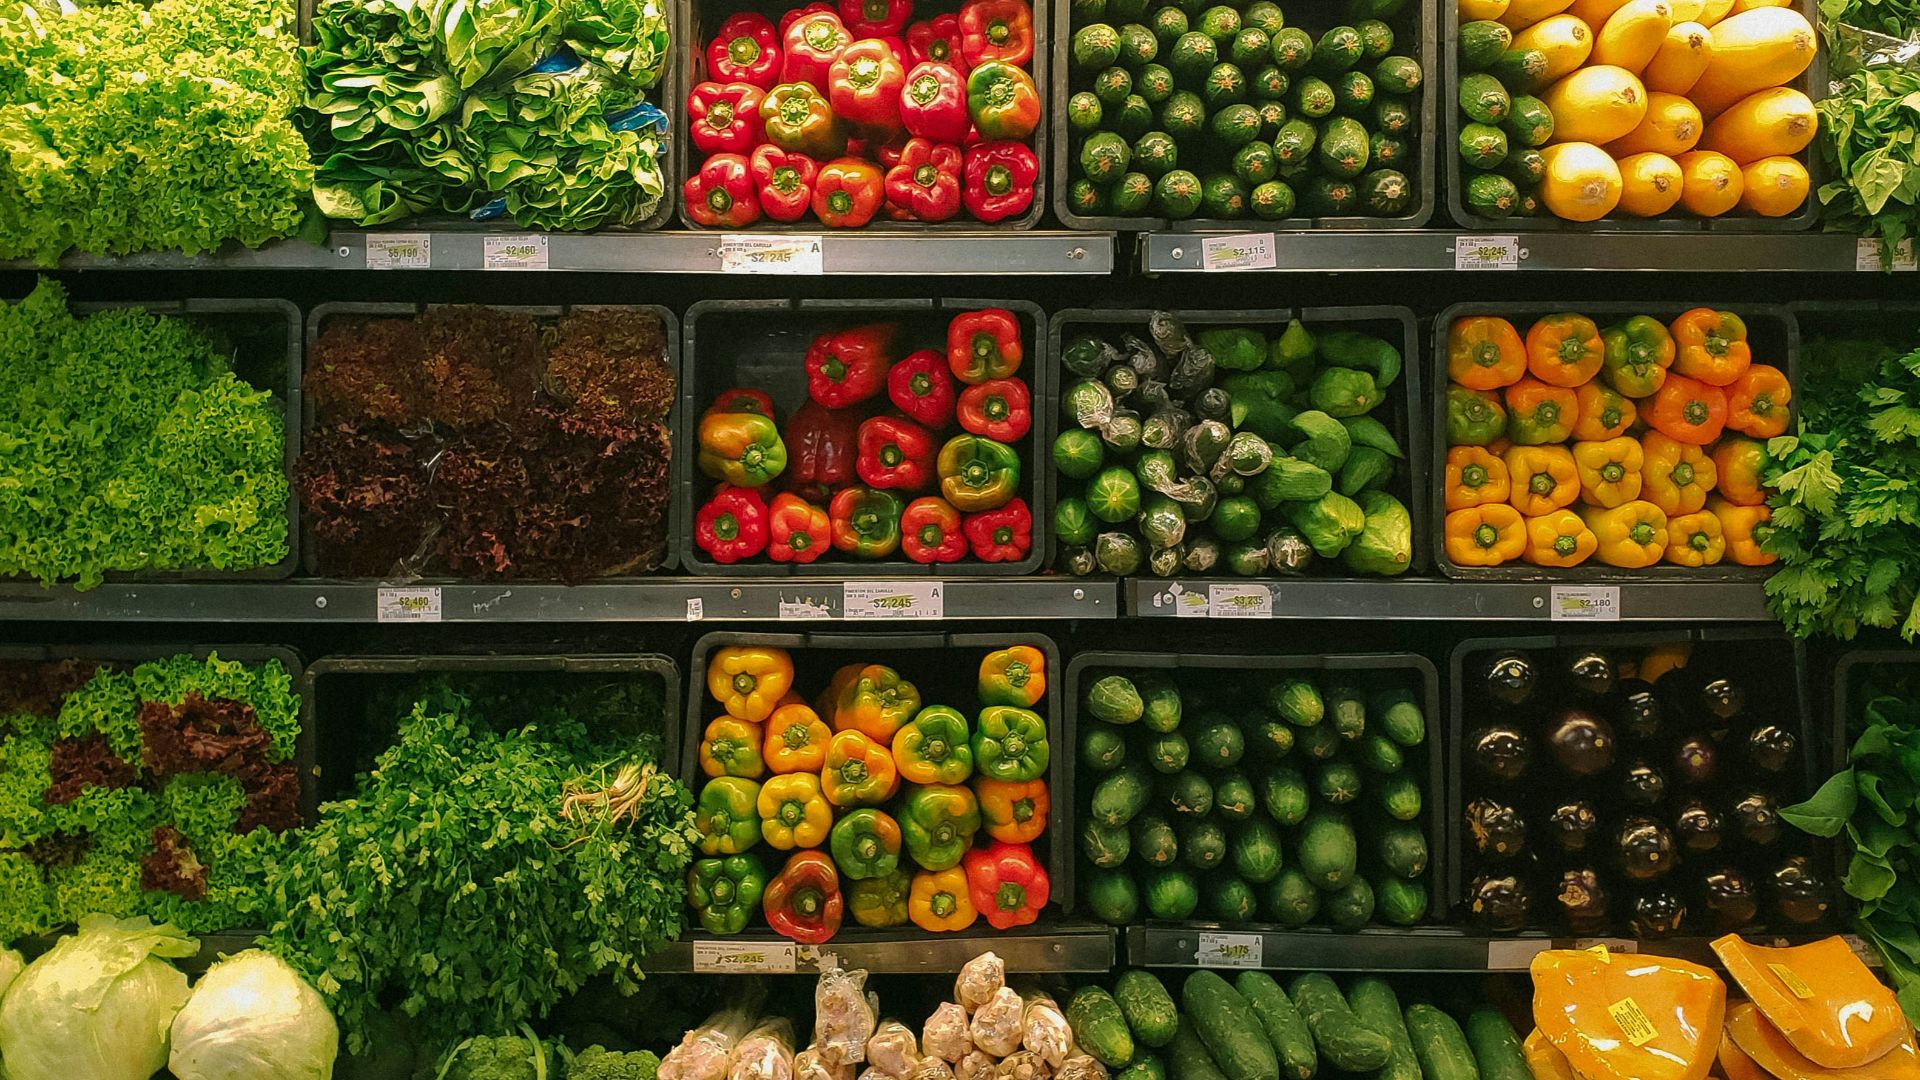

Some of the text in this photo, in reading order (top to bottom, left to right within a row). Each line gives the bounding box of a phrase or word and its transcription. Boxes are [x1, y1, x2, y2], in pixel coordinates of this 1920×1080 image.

[423, 239, 430, 249] C
[541, 236, 547, 246] C
[1513, 238, 1519, 247] A
[811, 242, 820, 253] A
[1478, 246, 1508, 258] $2,245
[751, 253, 791, 263] $2245
[434, 587, 440, 597] C
[931, 588, 940, 598] A
[873, 598, 912, 609] $2,245
[1254, 936, 1261, 946] A
[784, 947, 793, 956] A
[724, 954, 765, 964] $2,245
